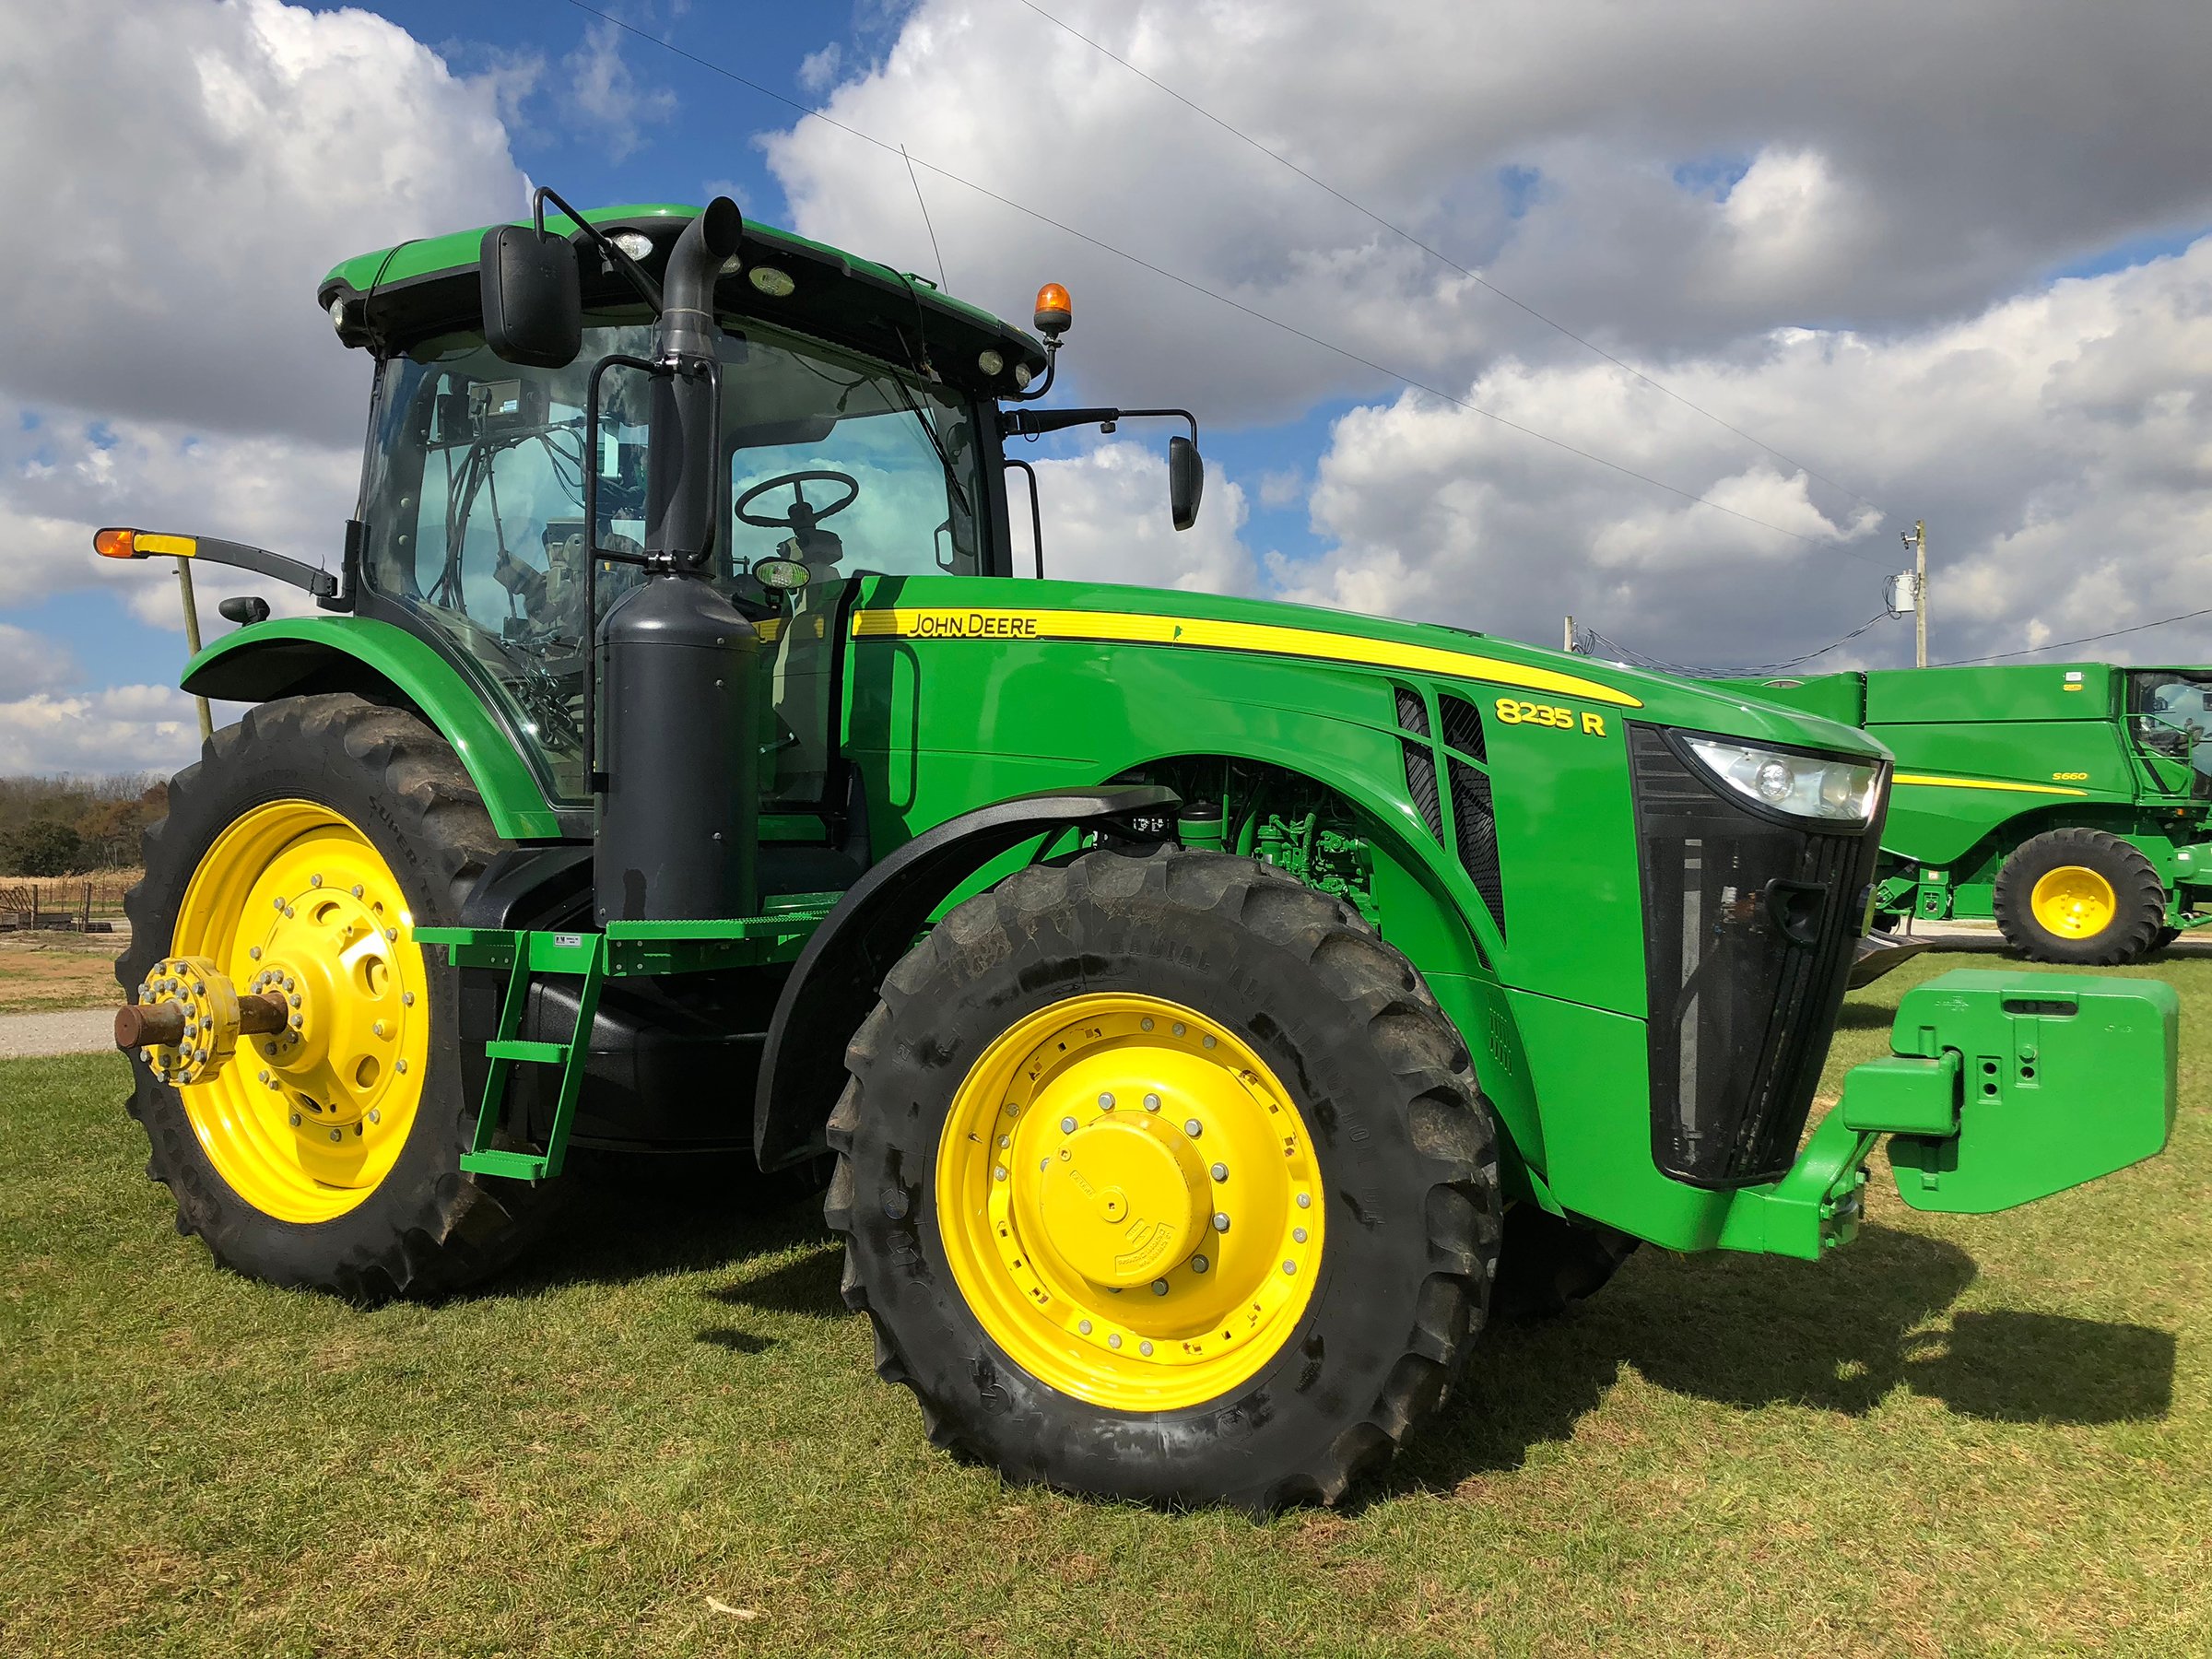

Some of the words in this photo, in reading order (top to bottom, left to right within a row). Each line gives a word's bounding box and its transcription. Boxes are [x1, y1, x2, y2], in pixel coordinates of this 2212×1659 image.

[910, 613, 962, 635] JOHN
[968, 613, 1038, 636] DEERE
[1495, 698, 1574, 730] 8235
[1580, 712, 1607, 738] R
[2052, 771, 2088, 781] S660
[369, 795, 418, 866] SUPER
